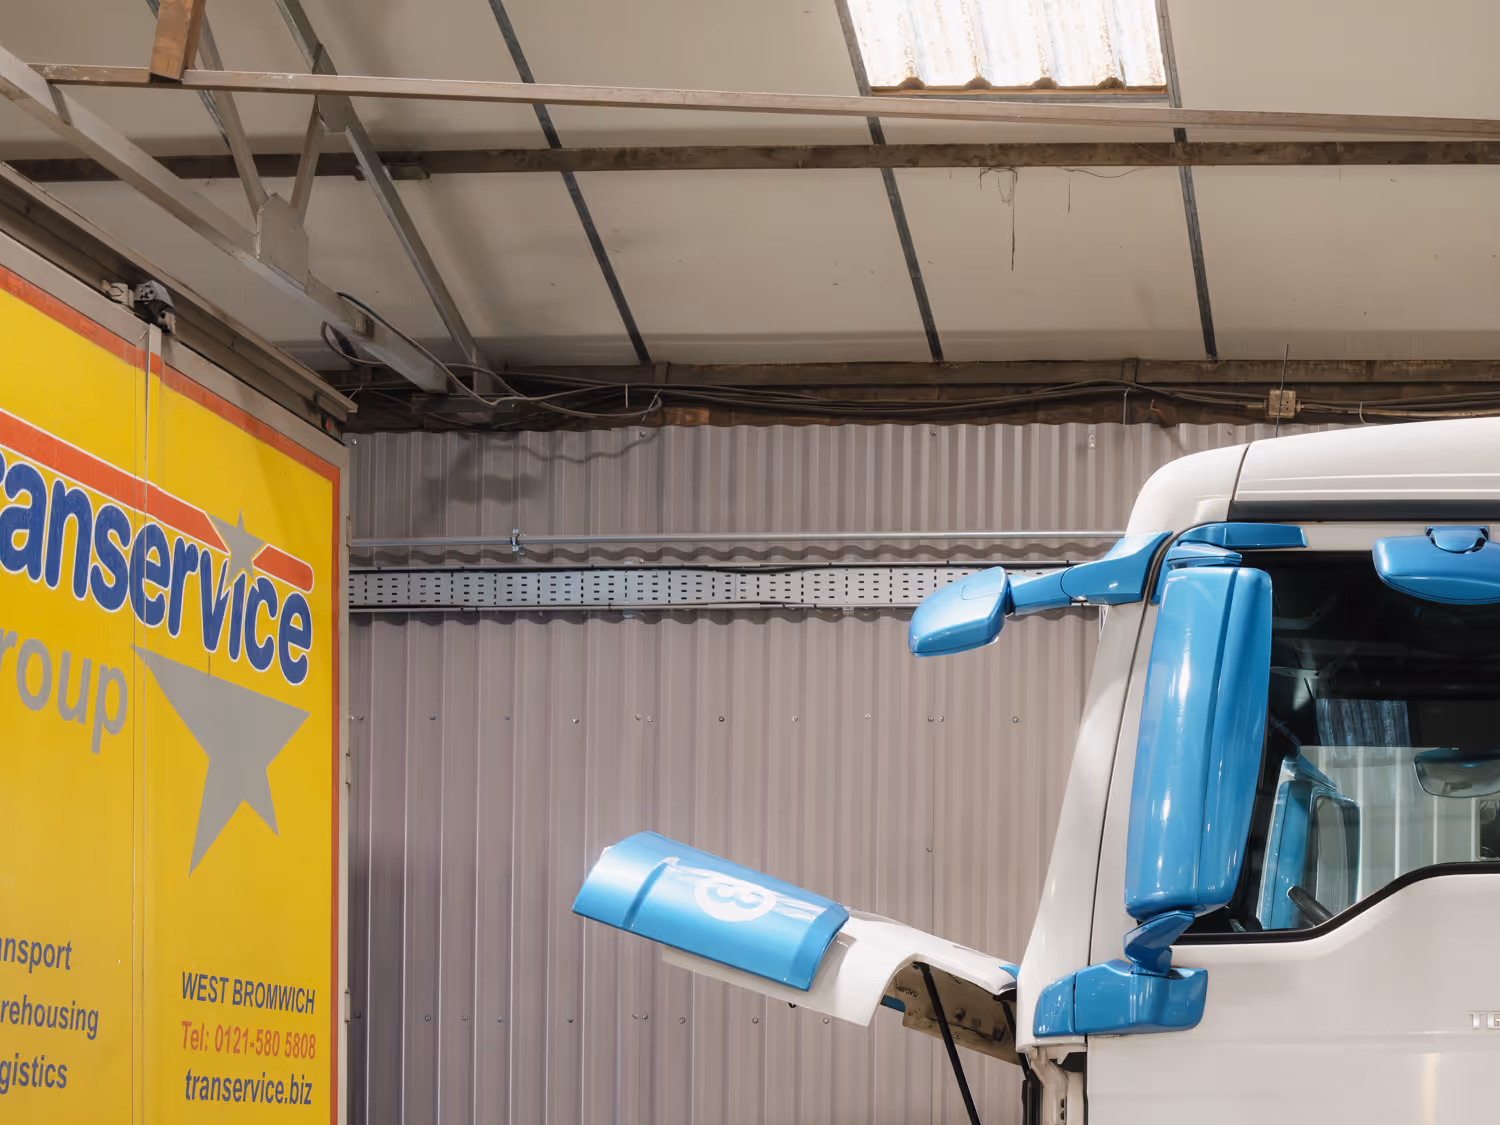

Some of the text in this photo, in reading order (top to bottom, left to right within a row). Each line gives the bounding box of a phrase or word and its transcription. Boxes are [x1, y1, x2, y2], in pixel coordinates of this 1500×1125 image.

[0, 937, 72, 974] nsport
[182, 971, 316, 1014] WEST BROMWICH
[0, 994, 99, 1041] rehousing
[182, 1020, 316, 1059] Tel: 0121-580 5808
[0, 1053, 68, 1095] gistics
[185, 1068, 313, 1105] transervice.biz
